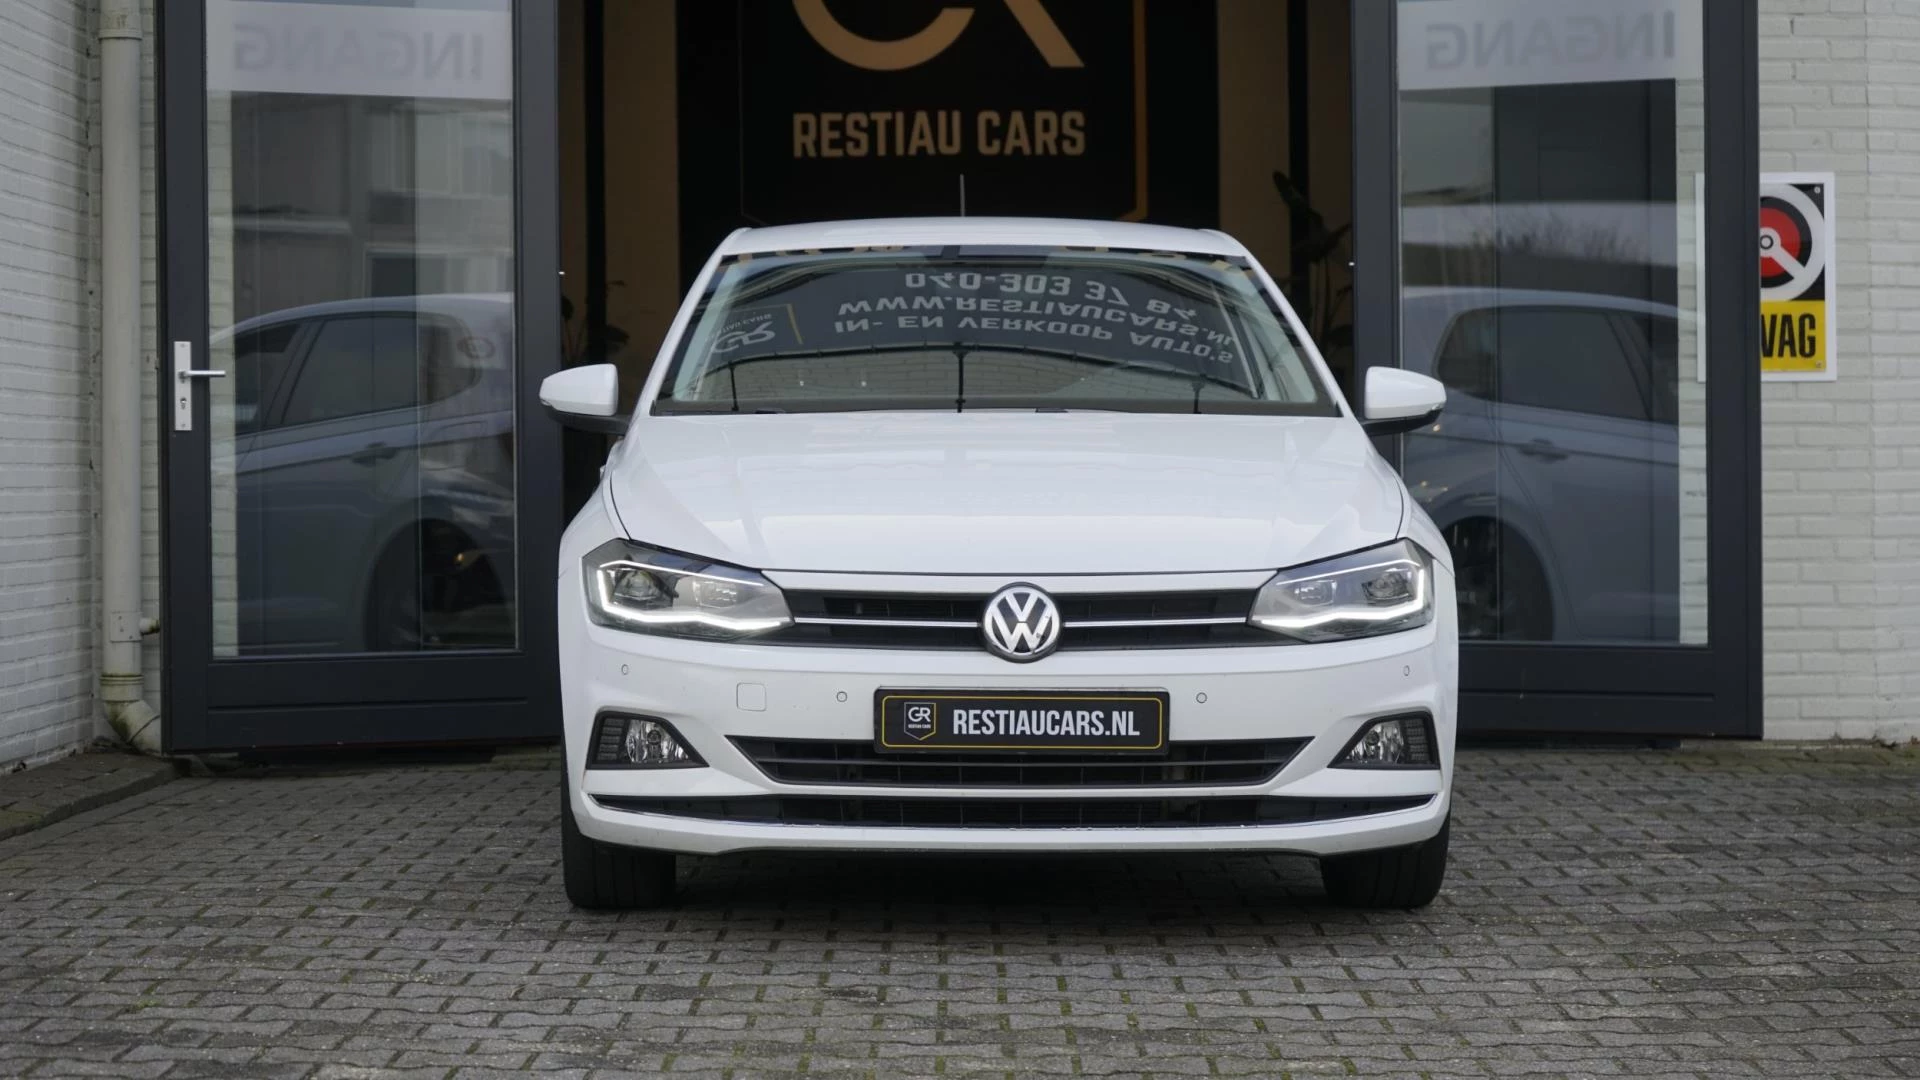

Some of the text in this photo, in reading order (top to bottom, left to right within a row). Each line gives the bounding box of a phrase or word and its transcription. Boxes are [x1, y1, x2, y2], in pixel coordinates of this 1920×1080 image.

[793, 110, 1086, 158] RESTIAU CARS
[1760, 313, 1816, 358] VAG
[953, 709, 1140, 736] RESTIAUCARS.NL
